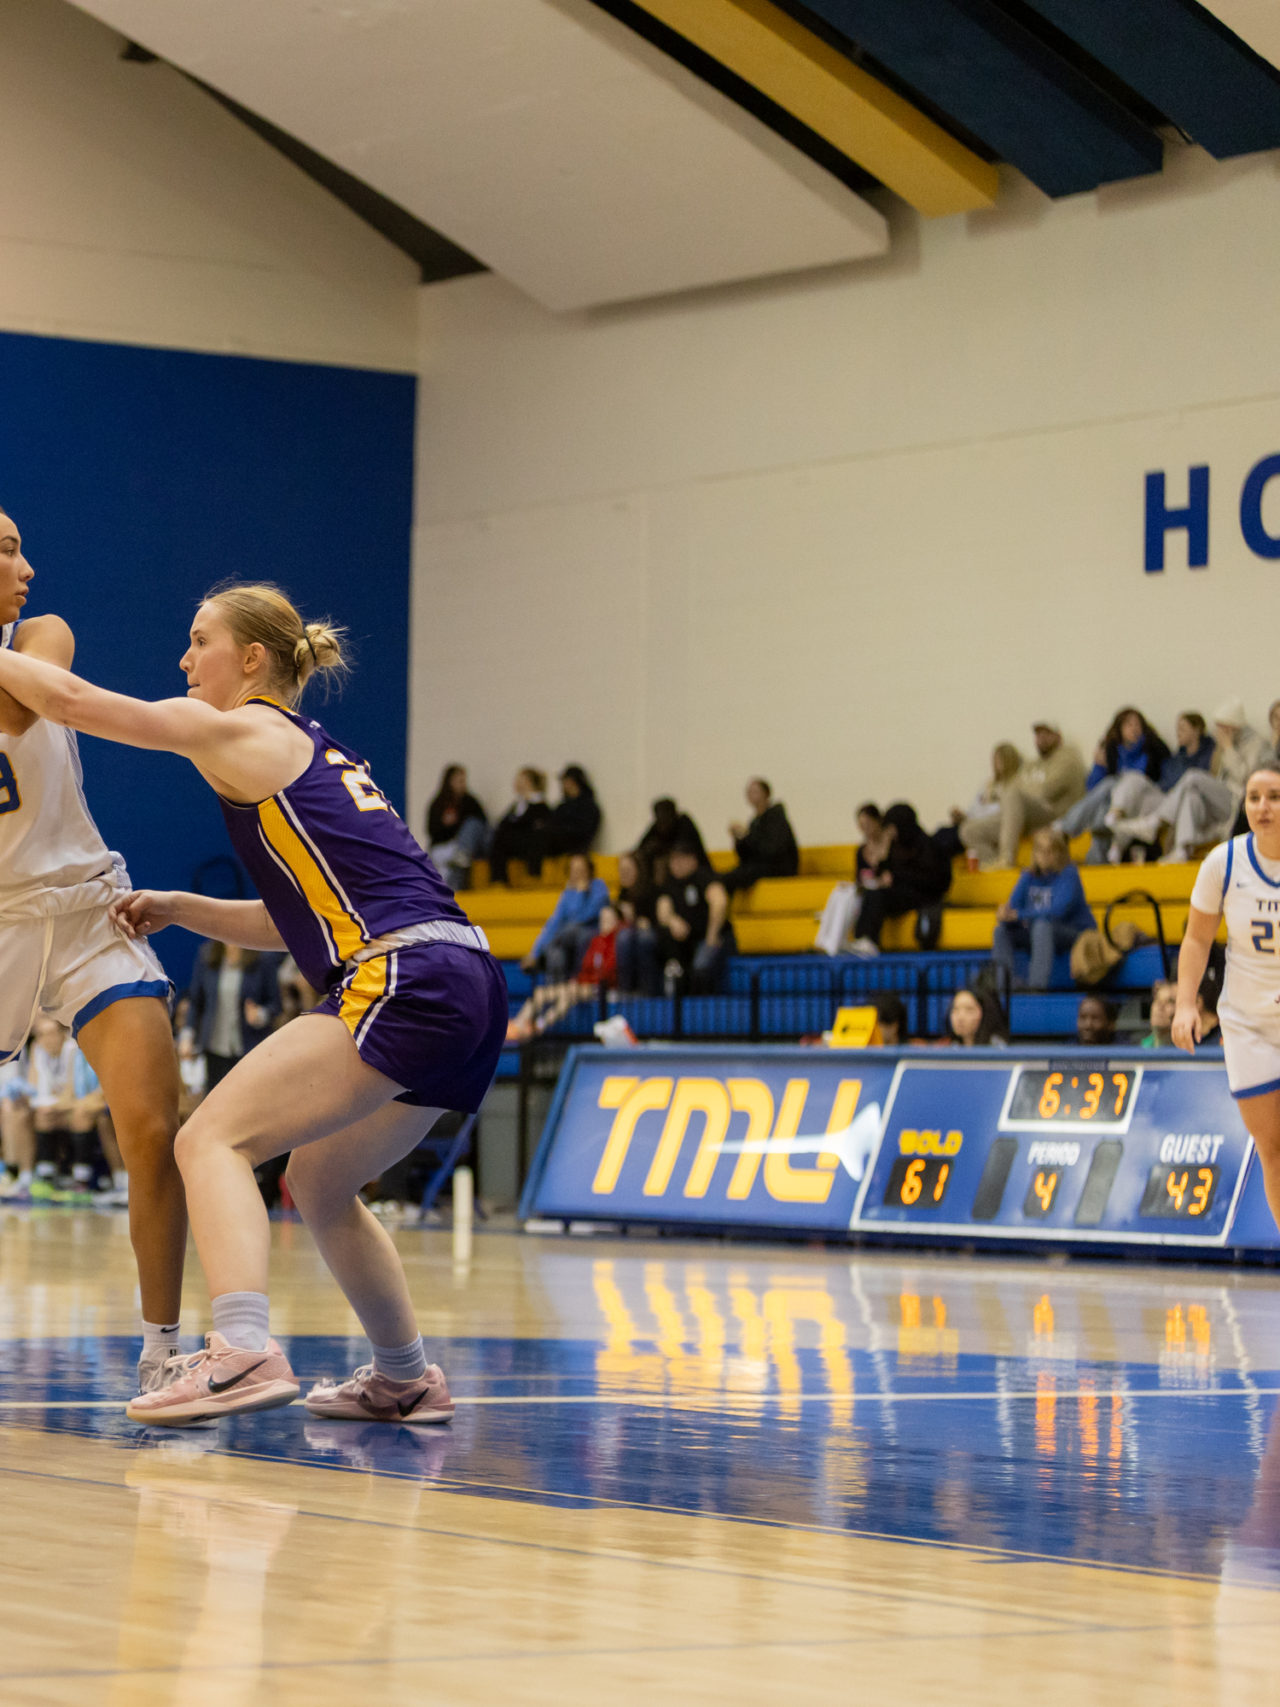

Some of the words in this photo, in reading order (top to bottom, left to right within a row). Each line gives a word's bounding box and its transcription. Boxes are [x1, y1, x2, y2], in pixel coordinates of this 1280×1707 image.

[325, 748, 389, 812] 2
[1250, 918, 1280, 956] 2
[1038, 1072, 1128, 1119] 6:37
[592, 1076, 862, 1203] TMU
[1027, 1141, 1081, 1166] PERIOD
[1159, 1133, 1225, 1165] GUEST
[901, 1158, 949, 1205] 61
[1034, 1171, 1057, 1211] 4
[1166, 1168, 1213, 1215] 43
